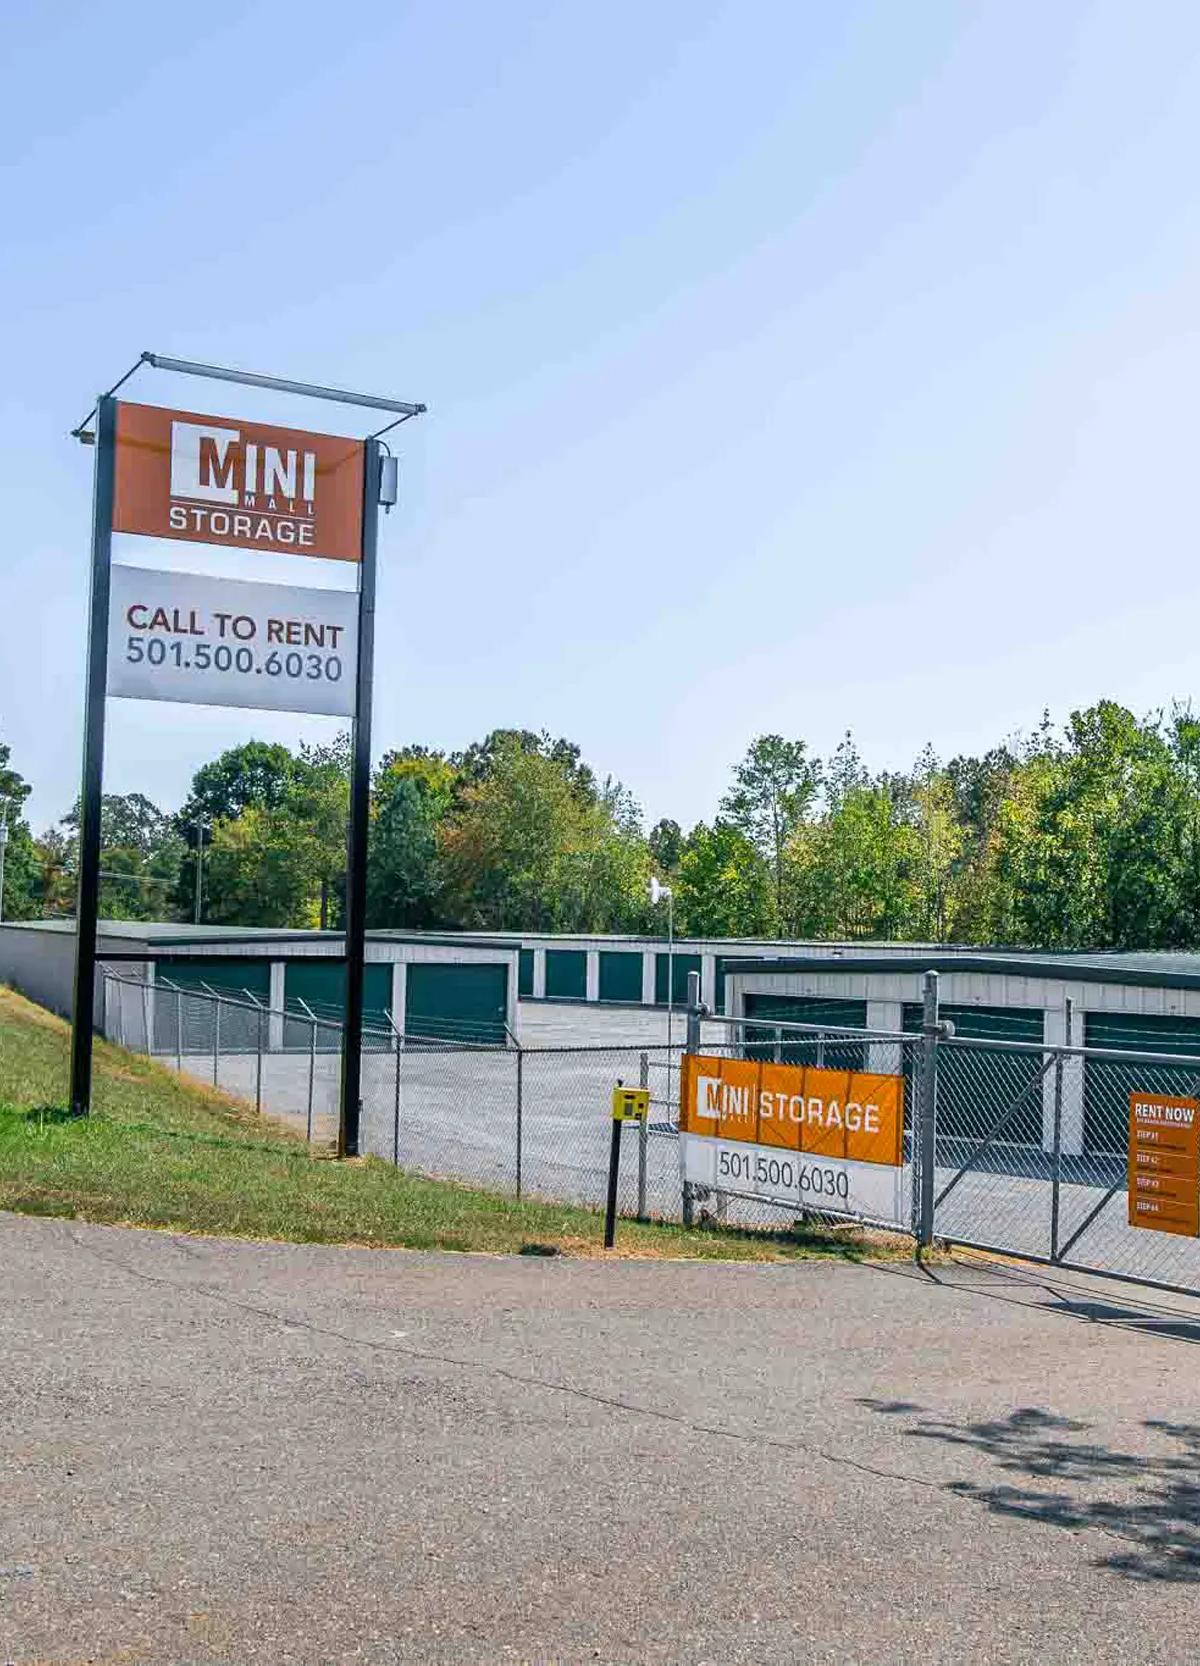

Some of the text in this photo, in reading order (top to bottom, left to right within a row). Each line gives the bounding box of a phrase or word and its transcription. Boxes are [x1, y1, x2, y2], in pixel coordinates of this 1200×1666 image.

[170, 420, 315, 503] MINI
[169, 506, 315, 545] STORAGE
[244, 494, 314, 515] MALL
[126, 604, 344, 649] CALL TO RENT
[126, 636, 343, 682] 501.500.6030
[697, 1075, 880, 1134] MINI STORAGE
[1135, 1103, 1195, 1122] RENT NOW
[719, 1151, 849, 1199] 501.500.6030
